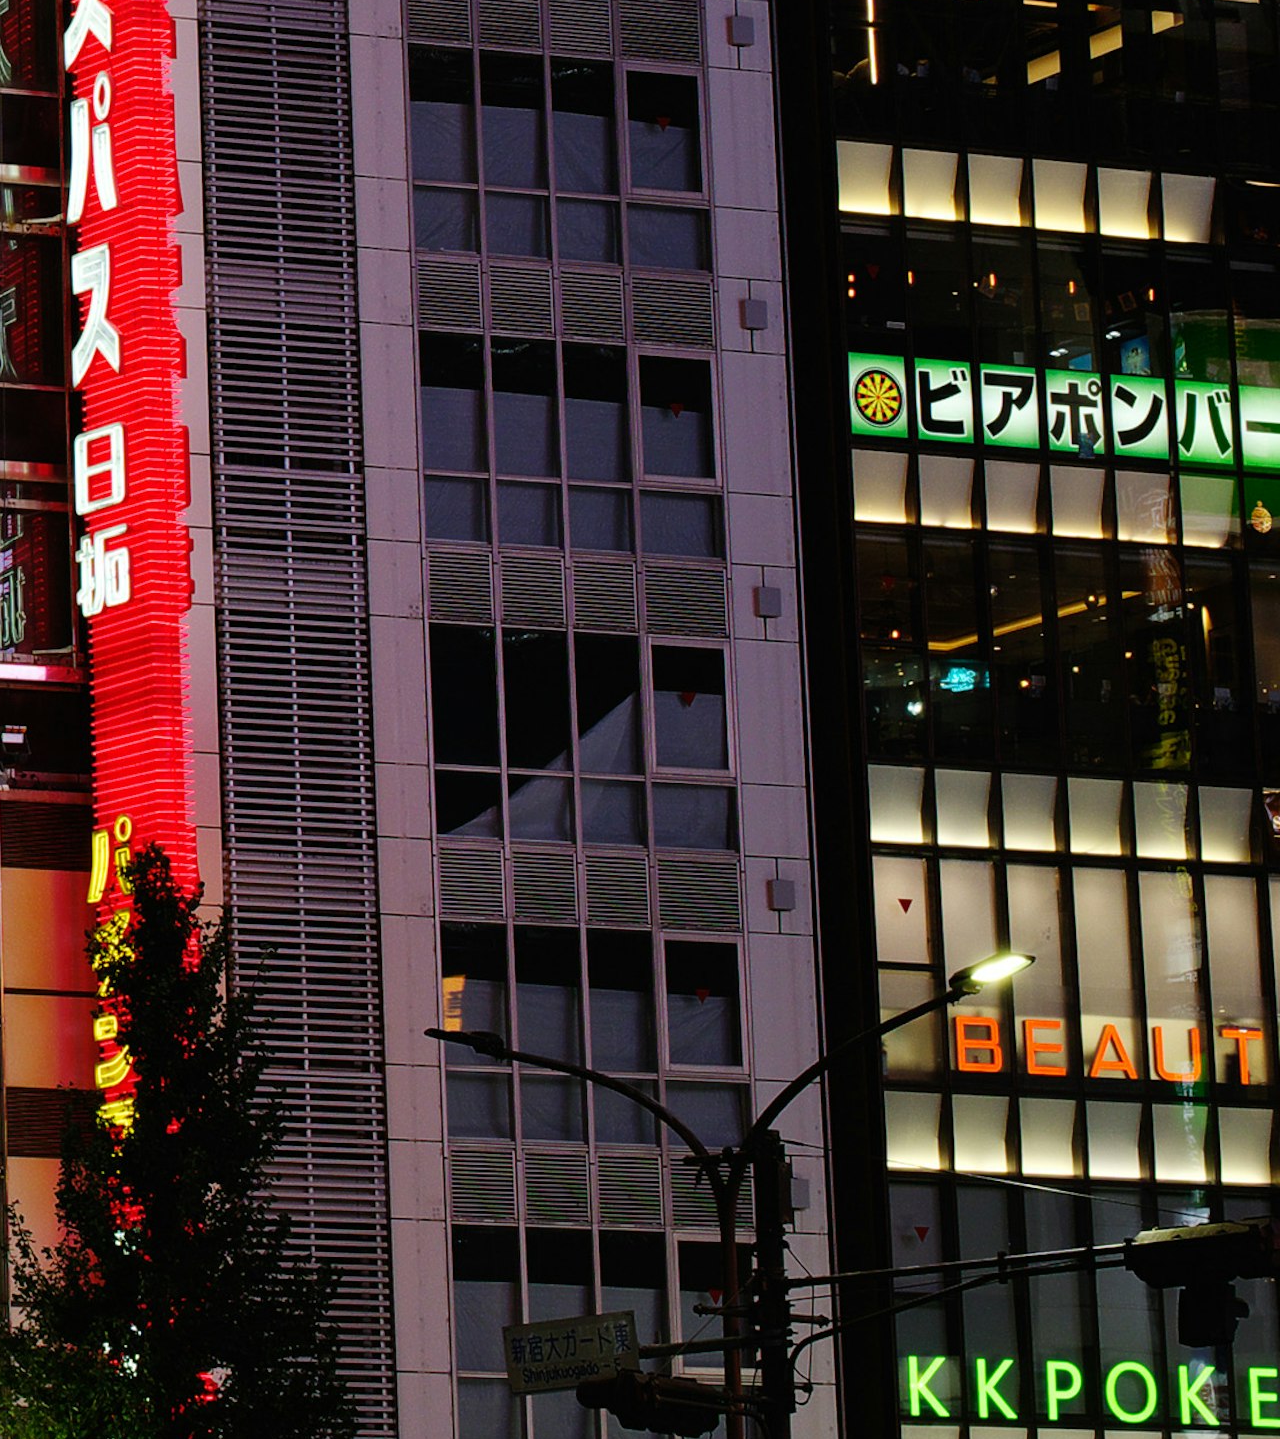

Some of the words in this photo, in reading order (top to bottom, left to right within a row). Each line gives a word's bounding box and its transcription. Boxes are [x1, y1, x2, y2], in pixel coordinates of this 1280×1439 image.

[73, 420, 131, 619] 日拓
[953, 1015, 1263, 1086] BEAUT
[511, 1323, 632, 1365] 新宿大ガード東
[906, 1355, 1280, 1429] KKPOKE
